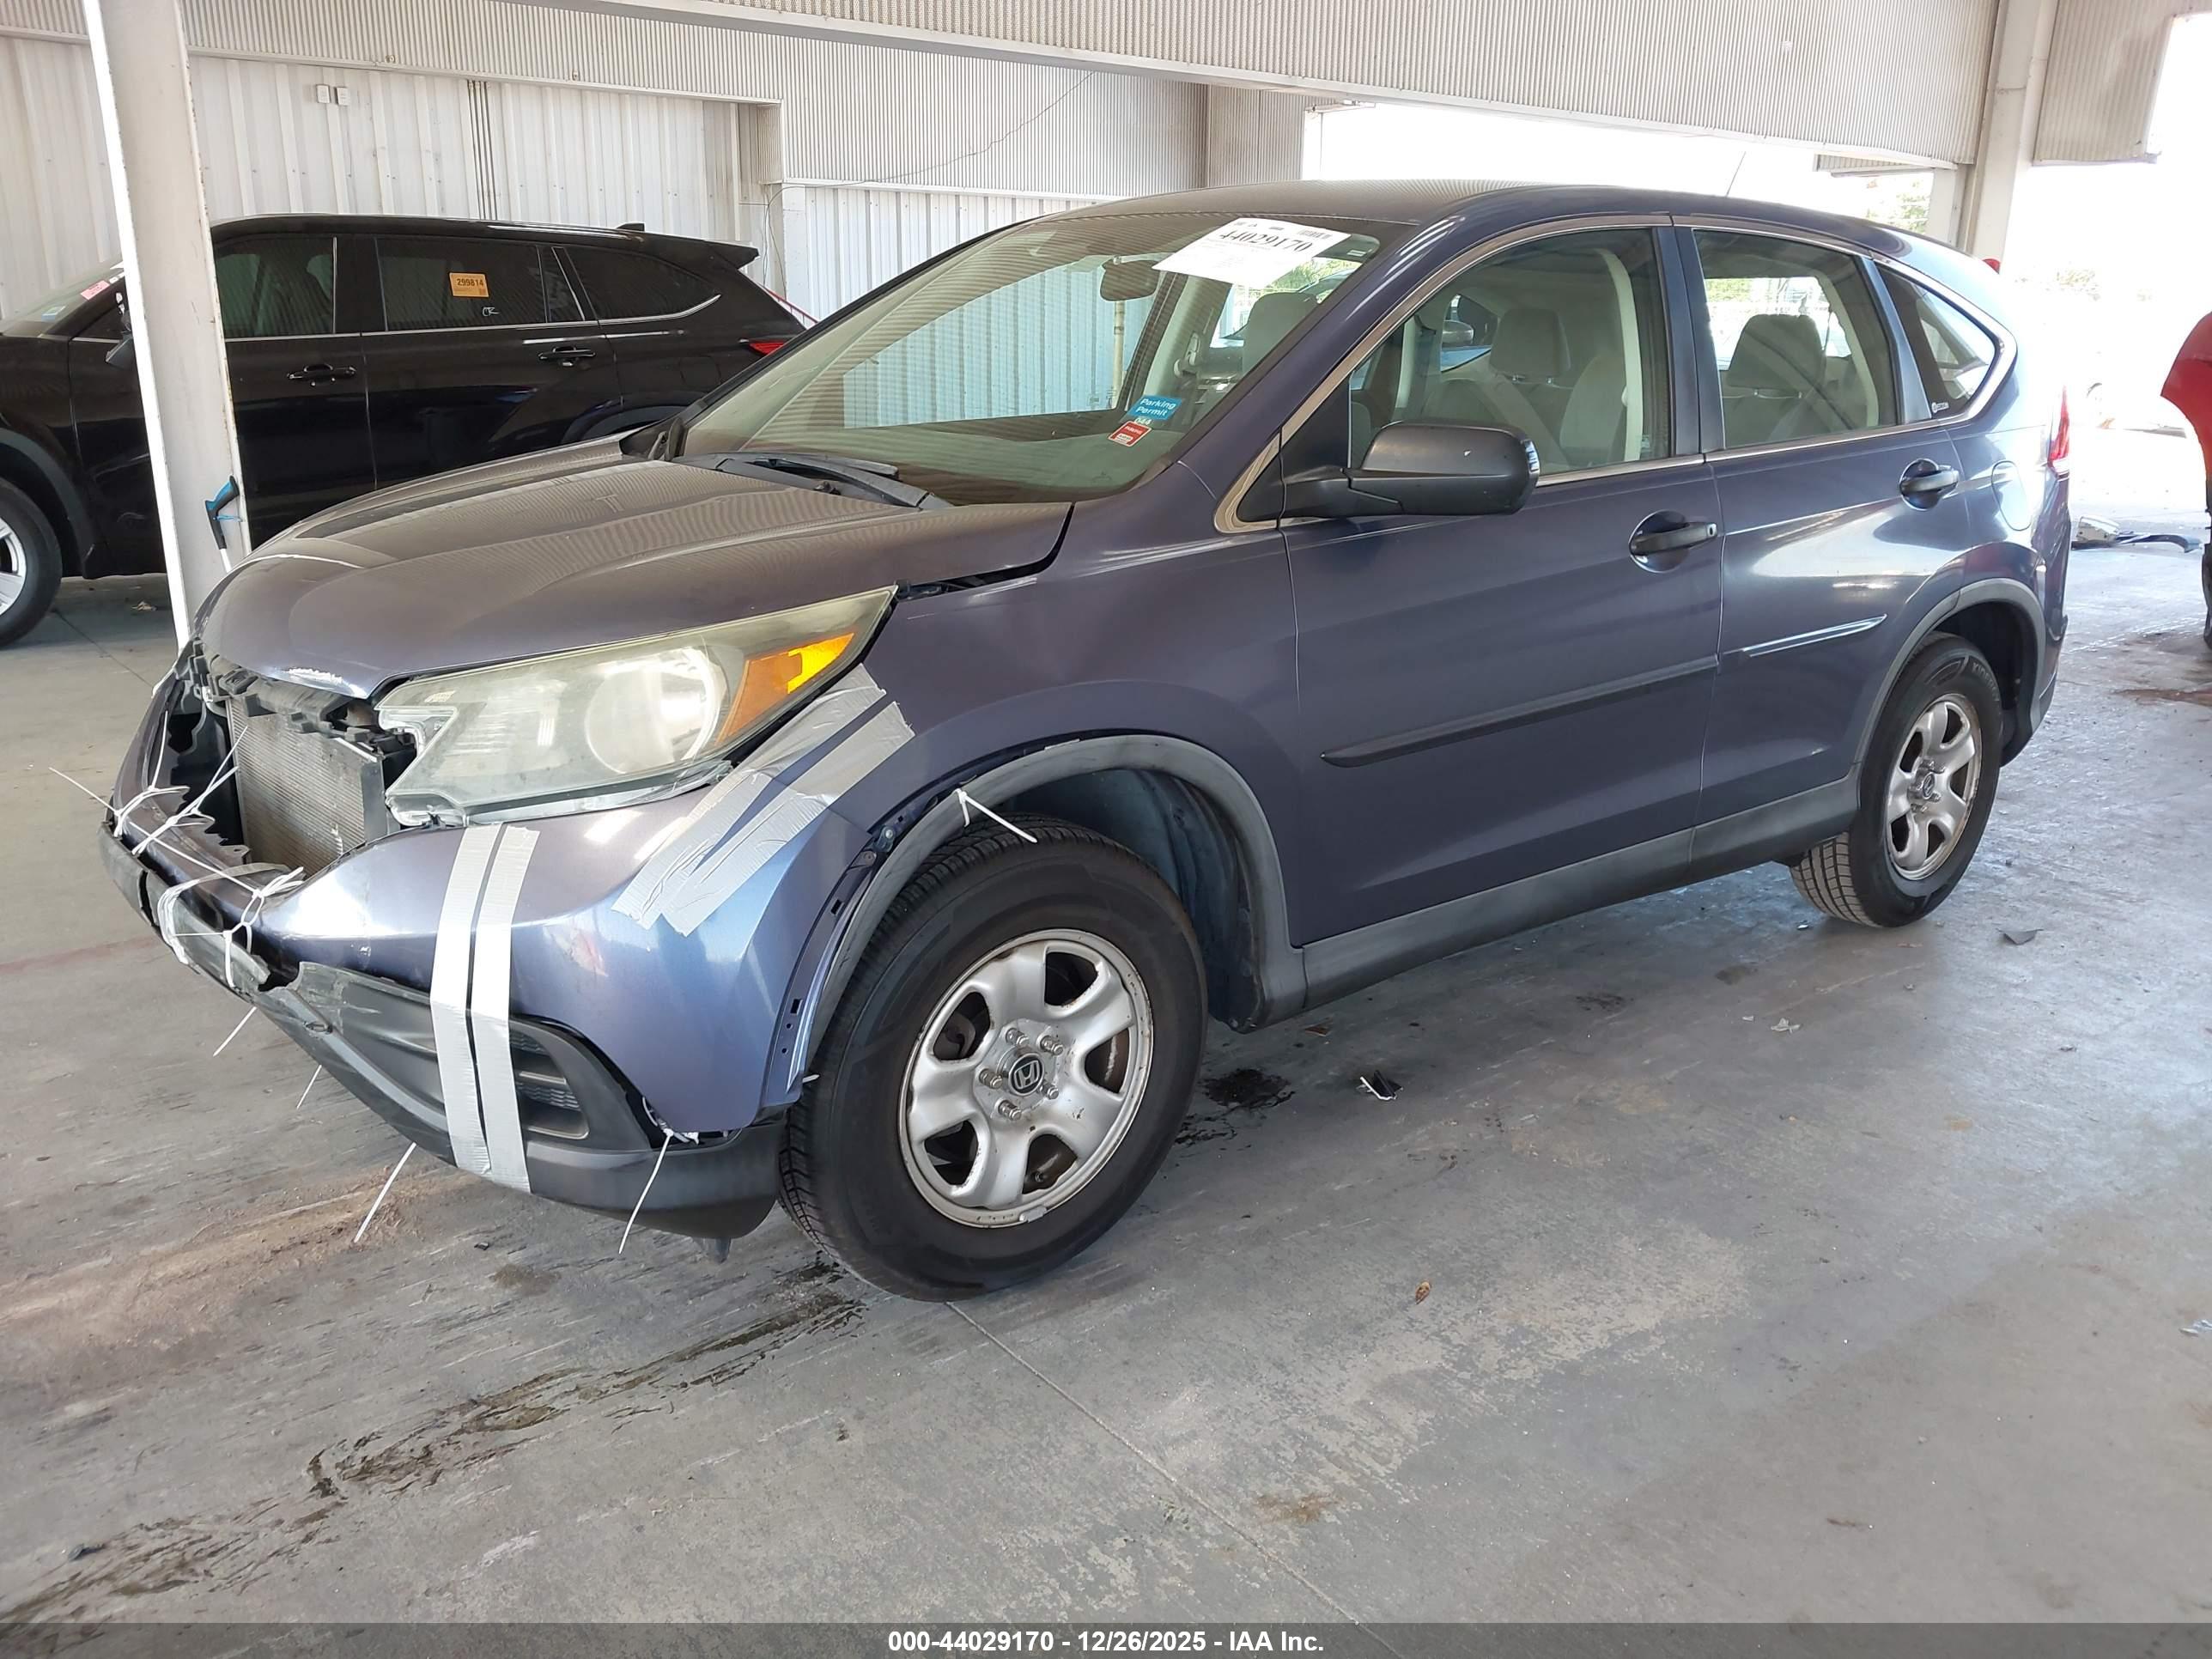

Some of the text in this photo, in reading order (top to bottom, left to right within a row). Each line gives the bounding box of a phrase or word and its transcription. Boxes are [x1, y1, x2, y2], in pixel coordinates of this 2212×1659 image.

[1218, 230, 1313, 252] 44029170
[456, 278, 484, 287] 299814
[1140, 398, 1176, 410] Parking
[1135, 406, 1168, 416] Permit
